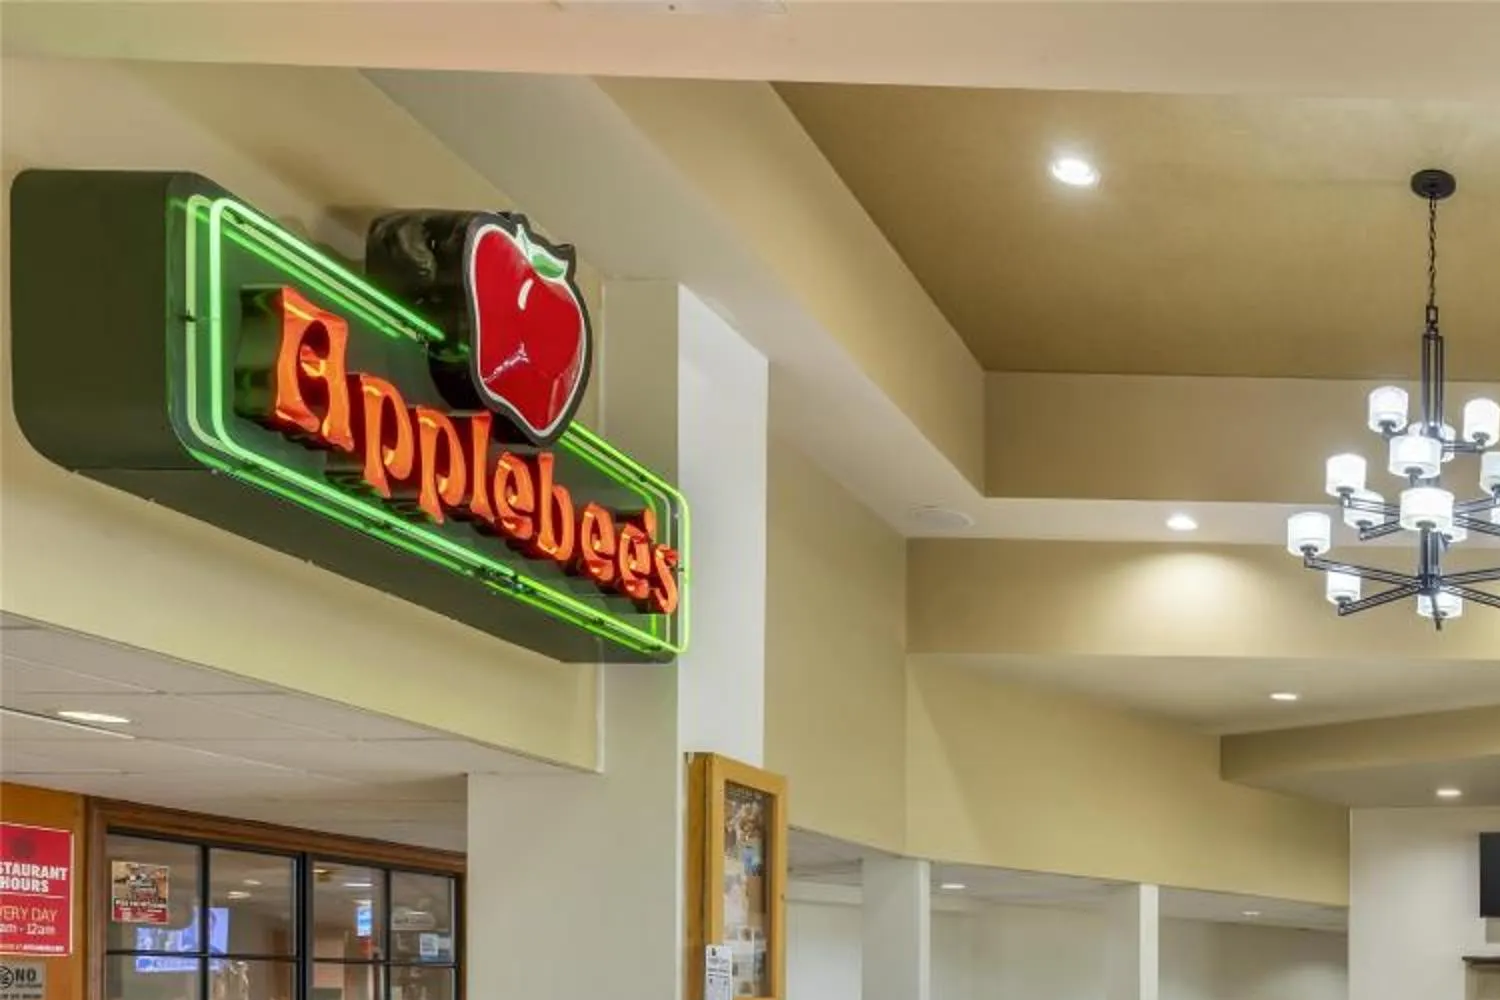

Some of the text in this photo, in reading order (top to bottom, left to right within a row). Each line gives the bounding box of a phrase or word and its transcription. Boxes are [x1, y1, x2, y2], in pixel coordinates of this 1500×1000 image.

[276, 286, 678, 614] Applebee's
[0, 876, 49, 893] HOURS
[32, 907, 58, 922] DAY
[15, 967, 37, 981] NO
